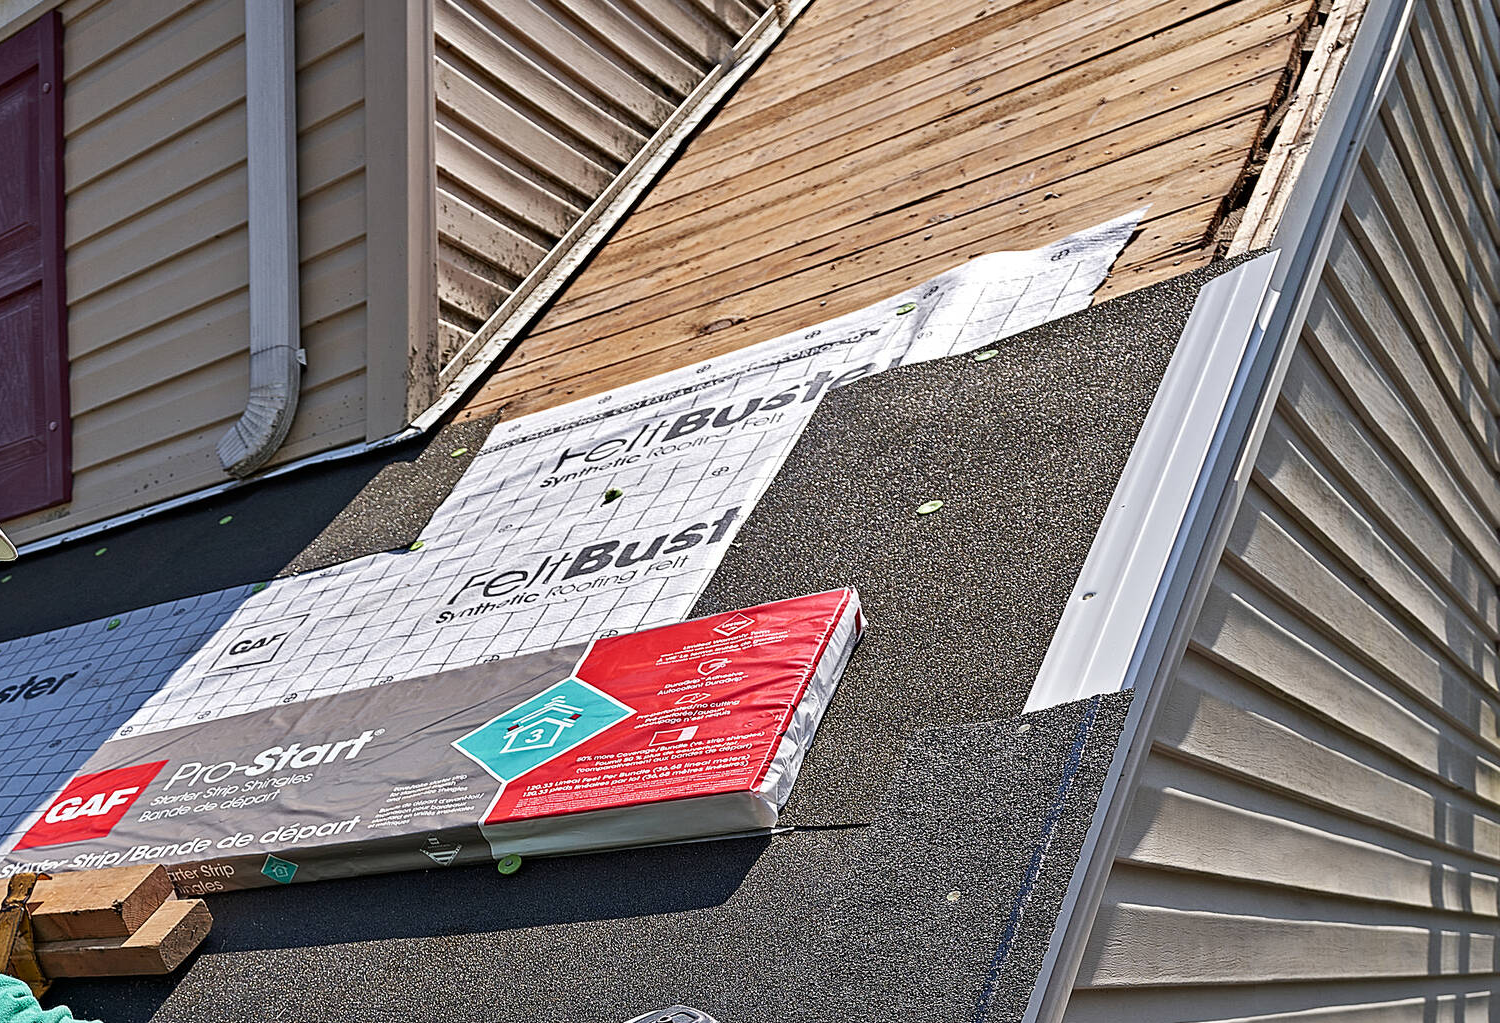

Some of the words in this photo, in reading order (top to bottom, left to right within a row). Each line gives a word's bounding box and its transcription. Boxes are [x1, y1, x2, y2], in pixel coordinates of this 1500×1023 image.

[551, 354, 904, 474] FeltBuste
[540, 452, 641, 488] Synthetic
[741, 411, 786, 432] Felt
[447, 506, 741, 605] FeltBust
[435, 591, 540, 625] Synthetic
[545, 569, 639, 600] Roofing
[644, 554, 689, 576] Felt
[229, 632, 288, 655] GAF
[524, 728, 545, 744] 3
[554, 778, 581, 787] Lineal
[581, 775, 601, 783] Feet
[618, 768, 651, 778] Bundle
[683, 758, 712, 769] lineal
[593, 753, 615, 761] more
[150, 790, 203, 806] Starter
[203, 784, 239, 801] Strip
[243, 772, 314, 794] Shingles
[610, 777, 628, 786] par
[45, 787, 140, 824] GAF
[137, 805, 190, 823] Bande
[193, 801, 218, 813] de
[220, 789, 281, 810] départ
[216, 831, 255, 849] de
[259, 816, 362, 845] départ
[167, 868, 200, 882] arter
[200, 863, 235, 879] Strip
[180, 880, 224, 895] ingles
